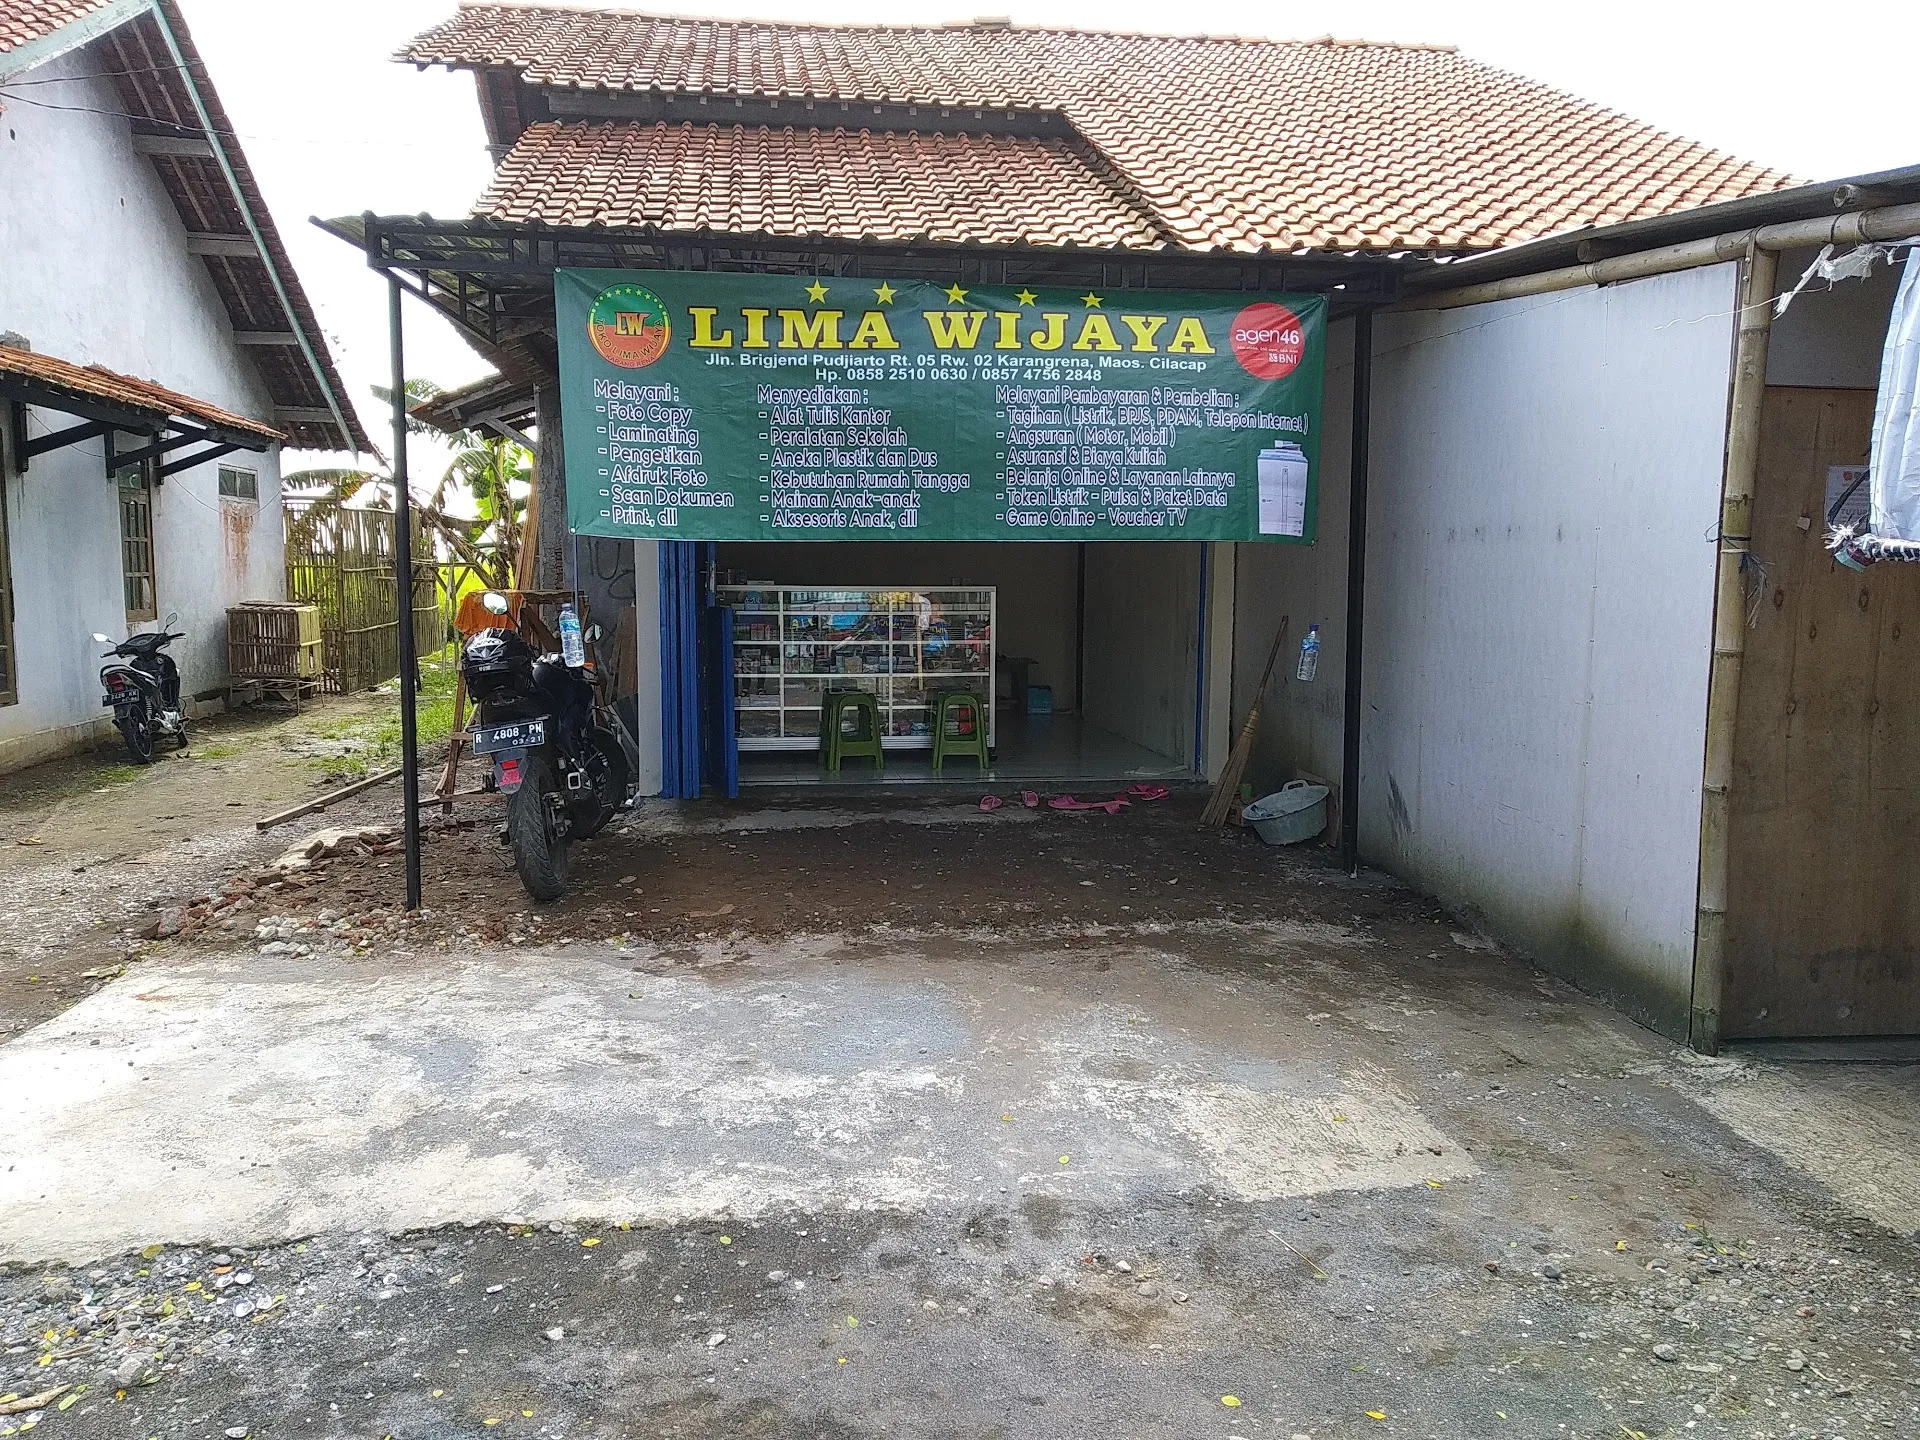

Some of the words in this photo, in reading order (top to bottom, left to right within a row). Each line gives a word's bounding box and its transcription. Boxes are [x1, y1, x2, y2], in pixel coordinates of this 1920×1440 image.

[615, 312, 652, 336] LW
[688, 306, 901, 350] LIMA
[922, 310, 1217, 355] WIJAYA
[596, 318, 612, 348] TOKO
[612, 347, 639, 359] LIMA
[641, 319, 663, 356] WIJAYA
[1236, 329, 1299, 345] agen46
[705, 353, 735, 366] Jln.
[740, 354, 807, 368] Brigjend
[813, 355, 885, 369] Pudjiarto
[890, 355, 911, 366] Rt.
[917, 355, 936, 366] 05
[941, 355, 969, 366] Rw.
[974, 355, 992, 367] 02
[998, 355, 1094, 370] Karangrena,
[1099, 356, 1144, 369] Maos.
[1150, 358, 1207, 372] Cilacap
[1279, 354, 1297, 364] BNI
[815, 368, 841, 383] Hp.
[847, 369, 884, 380] 0858
[889, 369, 925, 380] 2510
[930, 368, 968, 380] 0630
[972, 368, 977, 380] /
[981, 368, 1017, 380] 0857
[1023, 369, 1060, 381] 4756
[1065, 369, 1102, 381] 2848
[594, 379, 671, 404] Melayani
[757, 385, 860, 407] Menyediakan
[996, 385, 1060, 406] Melayani
[1061, 386, 1149, 408] Pembayaran
[1152, 387, 1161, 405] &
[1164, 388, 1233, 408] Pembelian
[608, 401, 645, 421] Foto
[648, 403, 692, 426] Copy
[770, 406, 804, 425] Alat
[806, 407, 839, 425] Tulis
[841, 407, 891, 425] Kantor
[1007, 406, 1062, 427] Tagihan
[1072, 406, 1116, 426] Listrik,
[1118, 407, 1155, 427] BPJS,
[1157, 408, 1203, 428] PDAM,
[1205, 409, 1256, 431] Telepon
[1258, 411, 1303, 432] Internet
[609, 422, 698, 447] Laminating
[771, 427, 844, 446] Peralatan
[847, 428, 908, 446] Sekolah
[1006, 426, 1074, 448] Angsuran
[1084, 426, 1128, 446] Motor,
[1131, 426, 1167, 445] Mobil
[610, 443, 702, 467] Pengetikan
[771, 448, 821, 467] Aneka
[824, 449, 874, 467] Plastik
[876, 449, 906, 467] dan
[908, 449, 938, 467] Dus
[1006, 446, 1067, 465] Asuransi
[1069, 447, 1079, 465] &
[1082, 447, 1122, 469] Biaya
[1124, 447, 1167, 466] Kuliah
[611, 464, 668, 484] Afdruk
[671, 467, 707, 486] Foto
[771, 470, 854, 488] Kebutuhan
[857, 470, 909, 488] Rumah
[912, 470, 970, 492] Tangga
[1006, 467, 1059, 489] Belanja
[1061, 467, 1106, 486] Online
[1109, 467, 1119, 486] &
[1121, 467, 1180, 489] Layanan
[1183, 468, 1235, 489] Lainnya
[612, 485, 653, 505] Scan
[655, 487, 734, 507] Dokumen
[772, 490, 828, 508] Mainan
[831, 490, 920, 508] Anak-anak
[1006, 488, 1046, 505] Token
[1049, 488, 1089, 505] Listrik
[1101, 487, 1138, 505] Pulsa
[1141, 489, 1151, 506] &
[1154, 488, 1192, 506] Paket
[1194, 488, 1227, 506] Data
[612, 505, 655, 527] Print,
[658, 508, 677, 526] dll
[772, 510, 846, 527] Aksesoris
[849, 510, 896, 529] Anak,
[899, 510, 917, 528] dll
[1006, 508, 1048, 526] Game
[1050, 508, 1095, 526] Online
[1108, 508, 1165, 526] Voucher
[1167, 509, 1187, 526] TV
[476, 734, 482, 743] R
[493, 727, 519, 740] 4808
